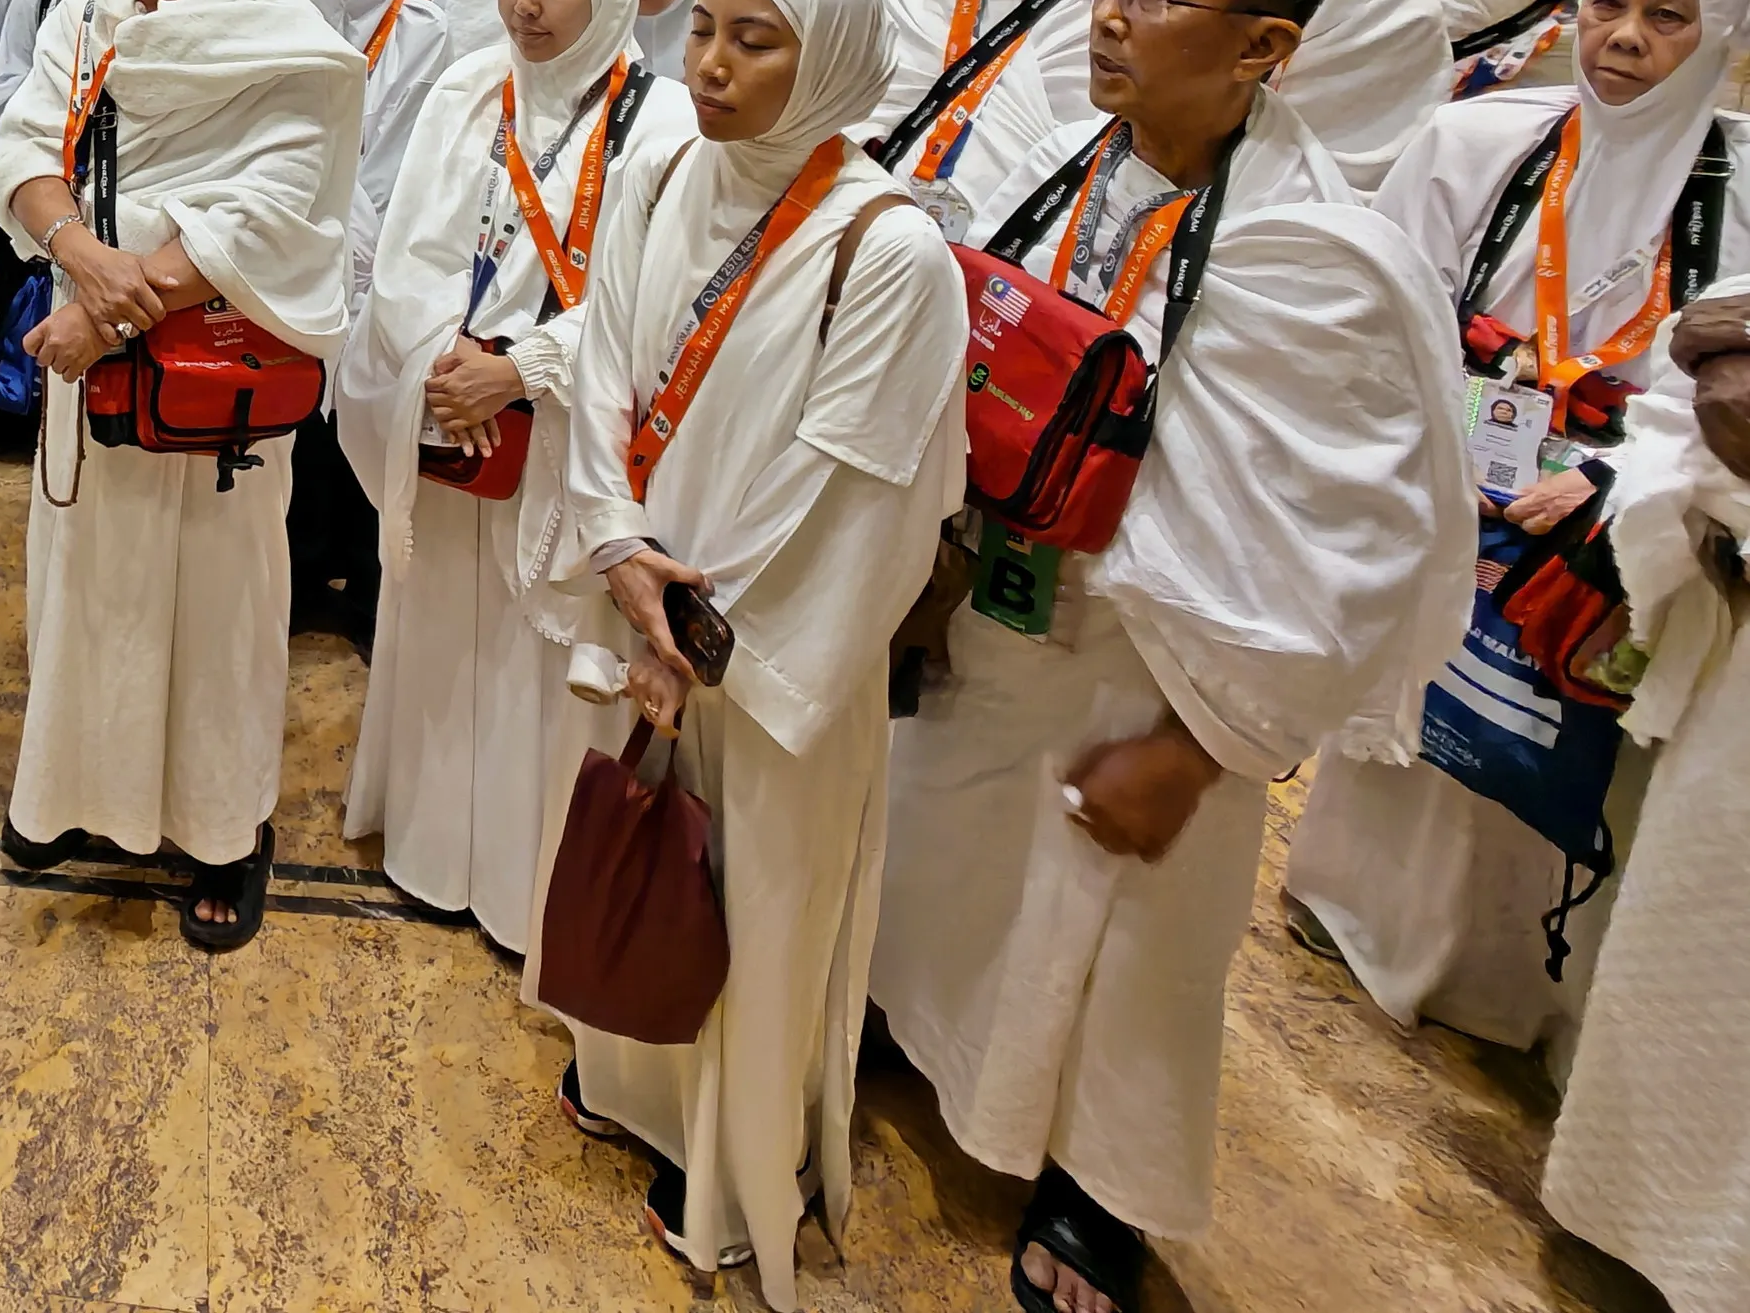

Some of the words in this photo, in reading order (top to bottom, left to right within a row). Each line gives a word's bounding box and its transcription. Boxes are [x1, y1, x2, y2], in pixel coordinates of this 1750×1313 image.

[585, 152, 597, 181] HAJI
[577, 180, 595, 231] JEMAAH
[711, 274, 725, 288] 01
[721, 251, 744, 277] 2570
[1110, 296, 1128, 321] AJI
[1120, 222, 1169, 294] MALAYSIA
[673, 349, 705, 401] JEMAAH
[699, 316, 722, 350] HAJI
[988, 556, 1036, 615] B
